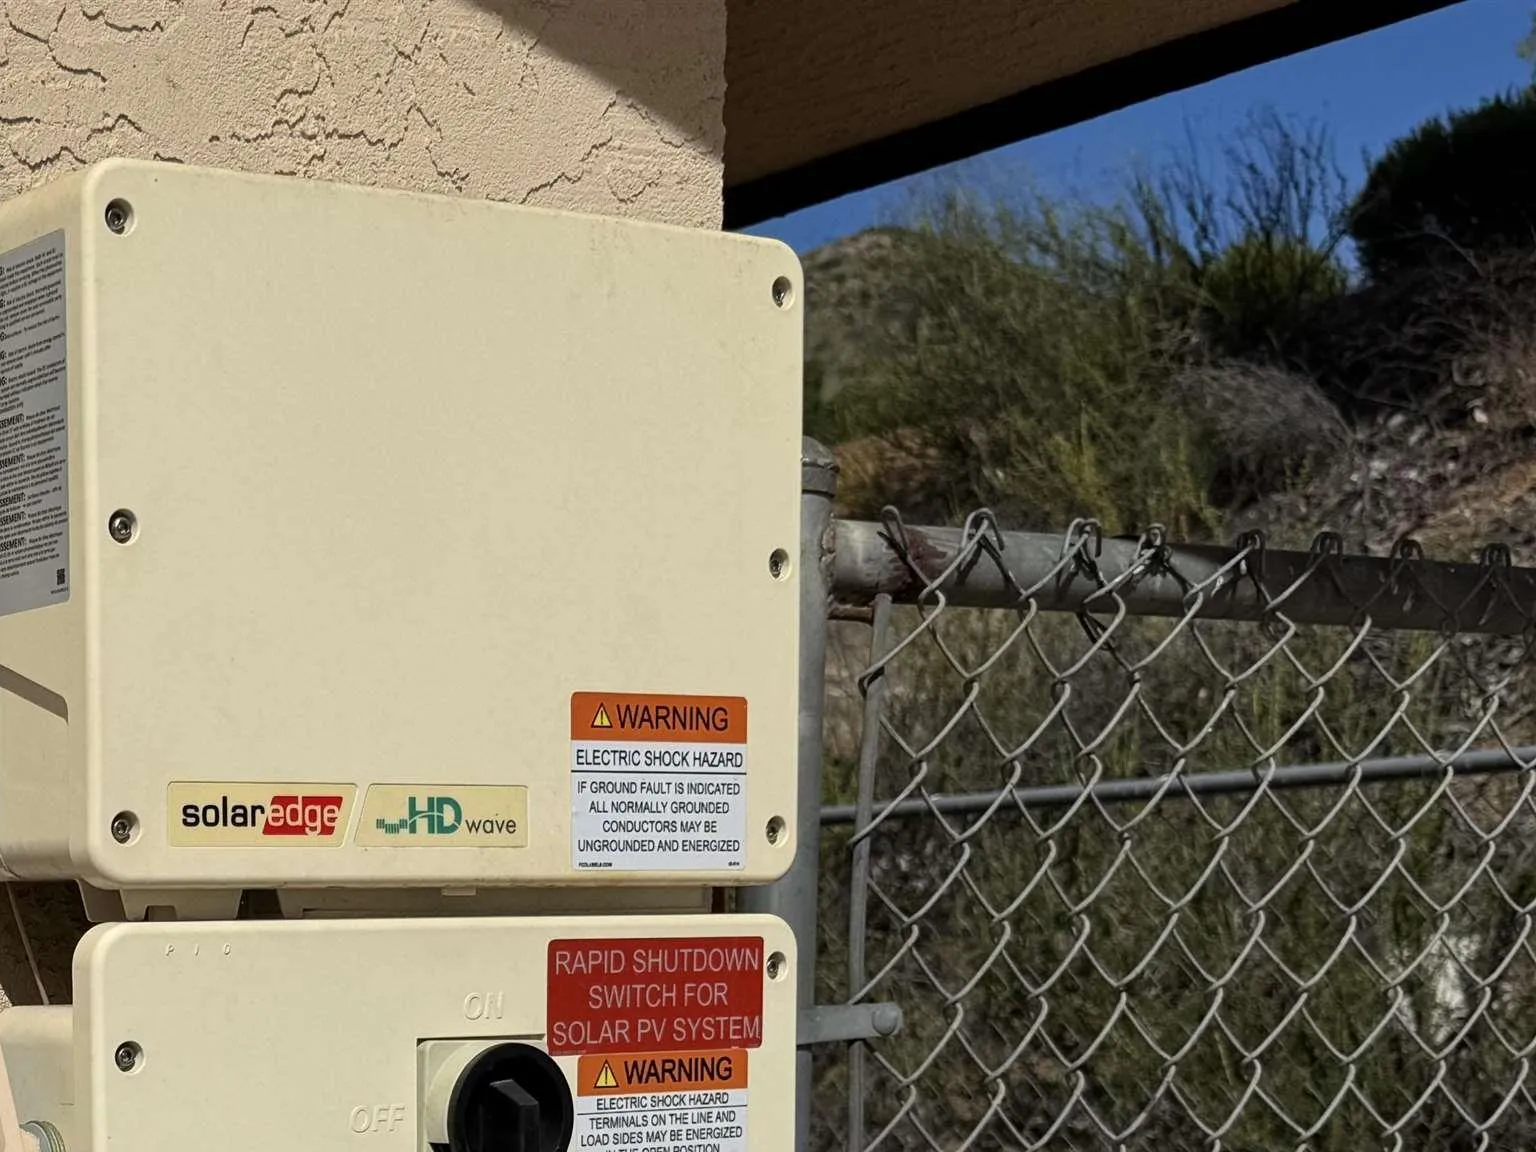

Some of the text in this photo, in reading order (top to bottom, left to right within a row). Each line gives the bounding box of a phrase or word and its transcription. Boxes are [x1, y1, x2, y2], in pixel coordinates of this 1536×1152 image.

[615, 703, 728, 732] WARNING
[576, 748, 743, 768] ELECTRIC SHOCK HAZARD
[577, 780, 740, 795] IF GROUND FAULT IS INDICATED
[181, 795, 341, 836] solaredge
[408, 795, 517, 835] HD wave
[555, 947, 759, 975] RAPID SHUTDOWN
[463, 991, 506, 1021] ON
[588, 982, 728, 1009] SWITCH FOR
[552, 1015, 760, 1046] SOLAR PV SYSTEM
[623, 1055, 732, 1085] WARNING
[596, 1091, 729, 1111] ELECTRIC SHOCK HAZARD
[349, 1103, 406, 1135] OFF
